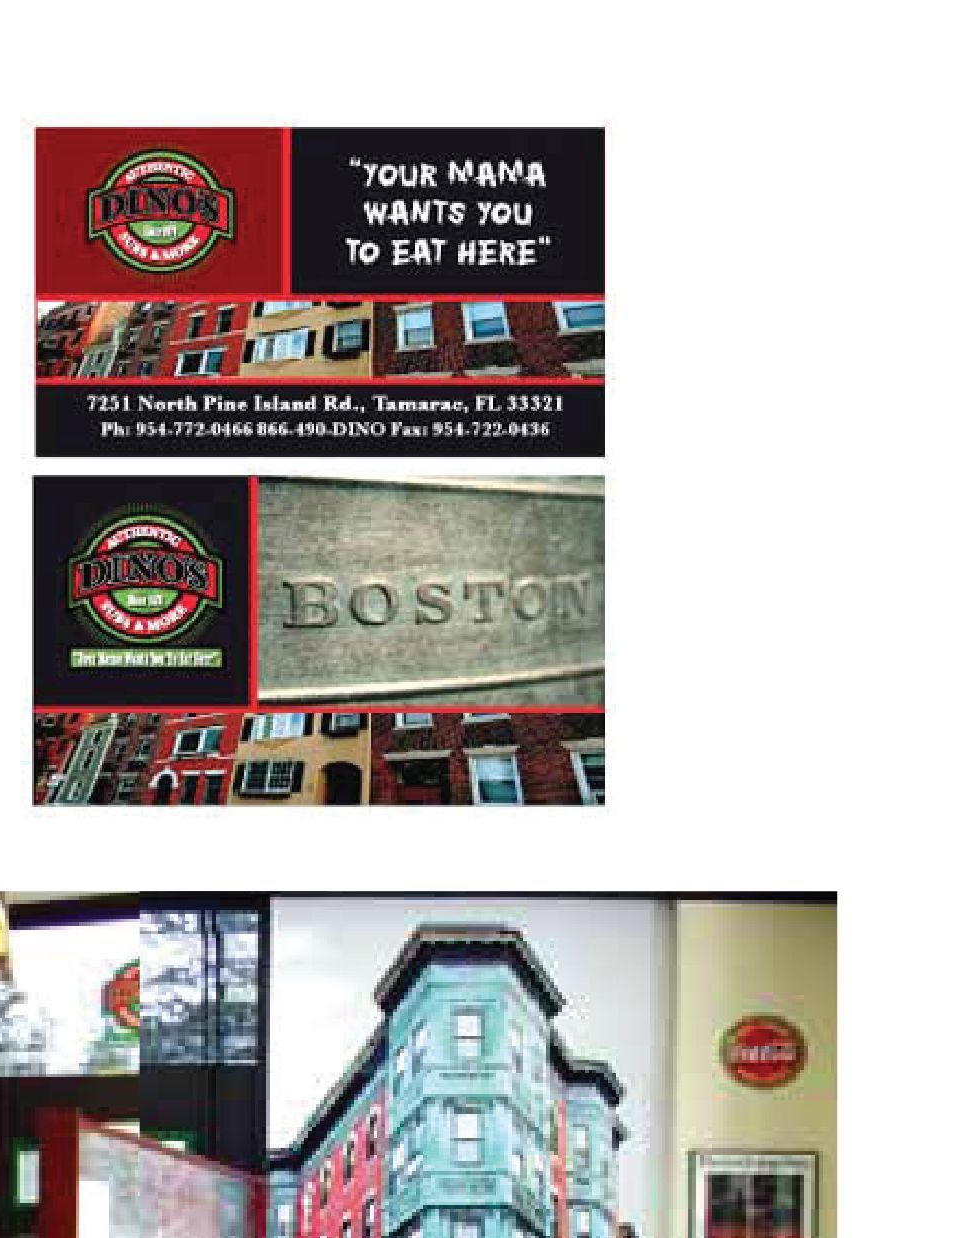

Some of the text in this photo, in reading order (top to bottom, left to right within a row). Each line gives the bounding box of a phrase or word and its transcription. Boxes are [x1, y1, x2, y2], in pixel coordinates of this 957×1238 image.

[447, 159, 547, 189] MAMA
[100, 186, 219, 223] DINO'S
[363, 198, 534, 226] WANTS YOU
[345, 237, 381, 266] TO
[391, 237, 446, 266] EAT
[86, 395, 130, 412] 7251
[138, 395, 198, 412] North
[202, 395, 249, 412] Pine
[254, 395, 317, 412] Island
[371, 395, 470, 414] Tamarac,
[475, 395, 502, 412] FL
[506, 395, 562, 412] 33321
[101, 421, 130, 437] Ph:
[390, 421, 428, 437] Fax:
[107, 525, 182, 550] AUTHENTIC
[80, 553, 208, 591] DINO'S
[281, 574, 590, 629] BOSTON
[147, 604, 188, 631] MORE
